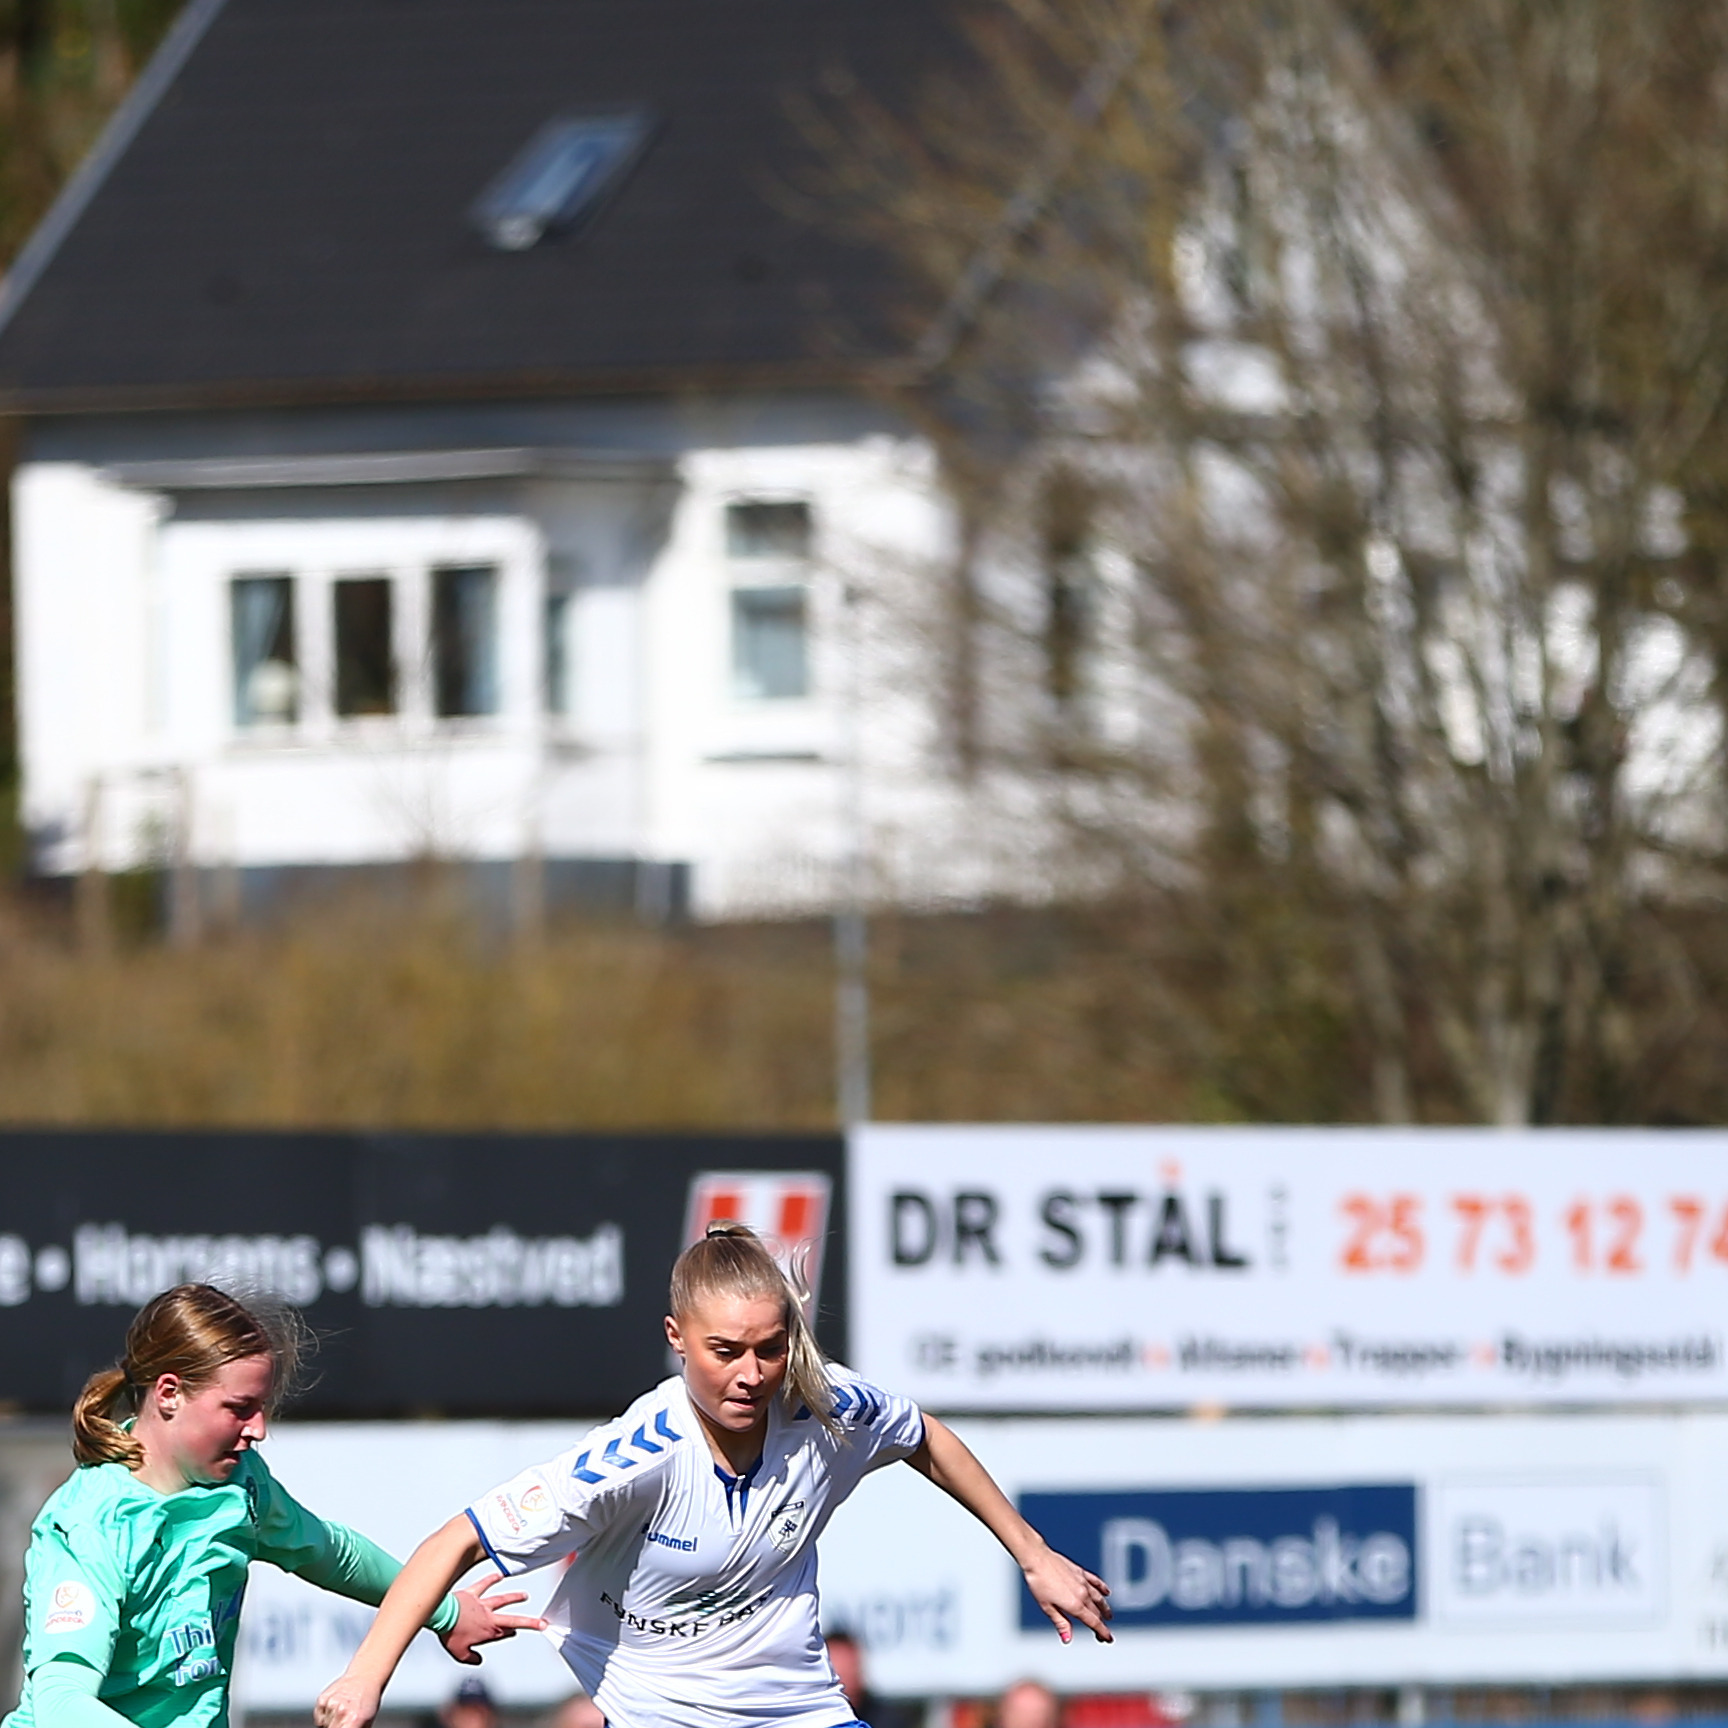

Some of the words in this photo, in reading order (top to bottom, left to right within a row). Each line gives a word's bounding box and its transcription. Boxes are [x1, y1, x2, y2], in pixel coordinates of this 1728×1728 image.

[889, 1189, 1001, 1269] DR
[1039, 1155, 1250, 1269] STÅL
[1339, 1191, 1425, 1276] 25
[1452, 1191, 1535, 1276] 73
[1563, 1191, 1643, 1276] 12
[74, 1220, 322, 1308] Horsens
[360, 1221, 623, 1307] Næstved
[1100, 1514, 1410, 1612] Danske
[1455, 1514, 1644, 1597] Bank
